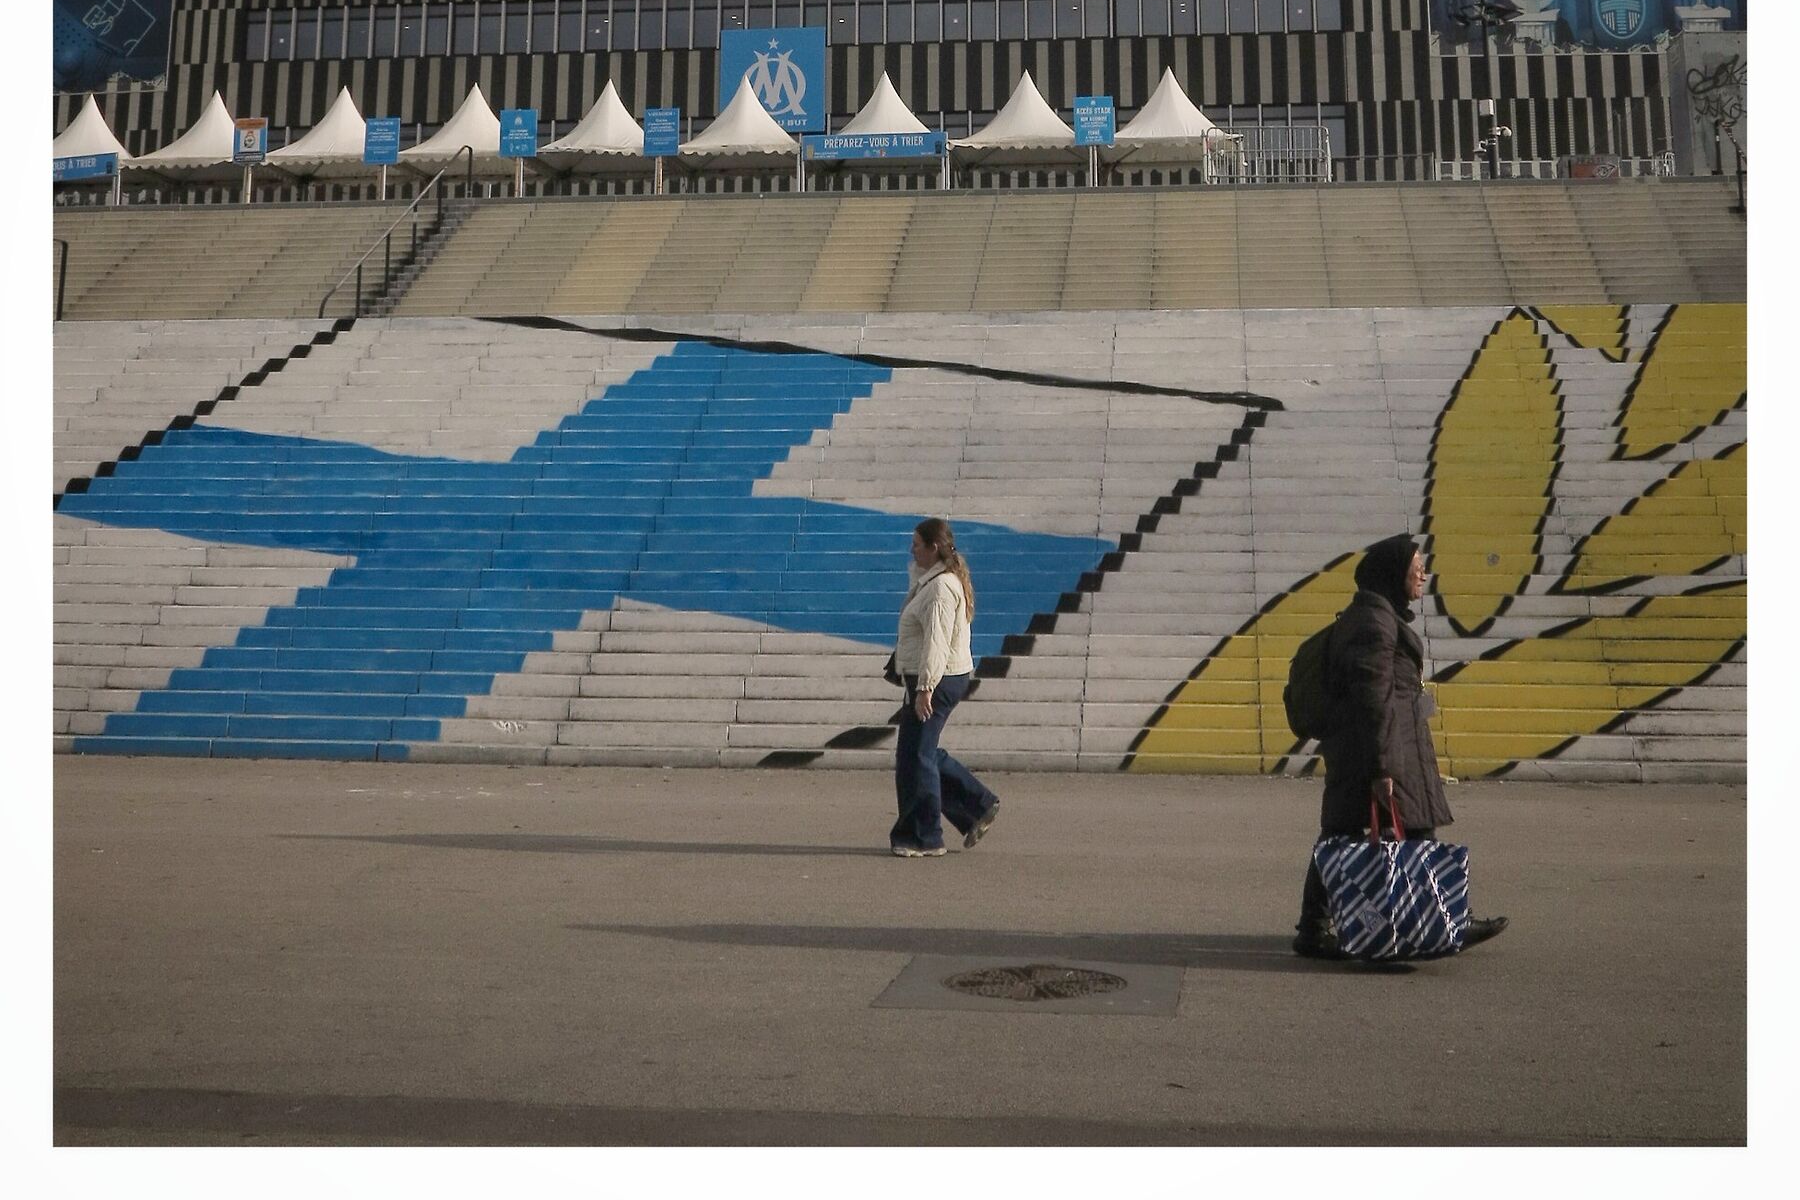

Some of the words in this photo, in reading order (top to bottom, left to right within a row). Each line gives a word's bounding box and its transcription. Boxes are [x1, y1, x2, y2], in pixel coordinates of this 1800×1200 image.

[824, 137, 890, 149] PRÉPAREZ-VOUS
[901, 136, 924, 146] TRIER
[76, 157, 96, 168] TRIER
